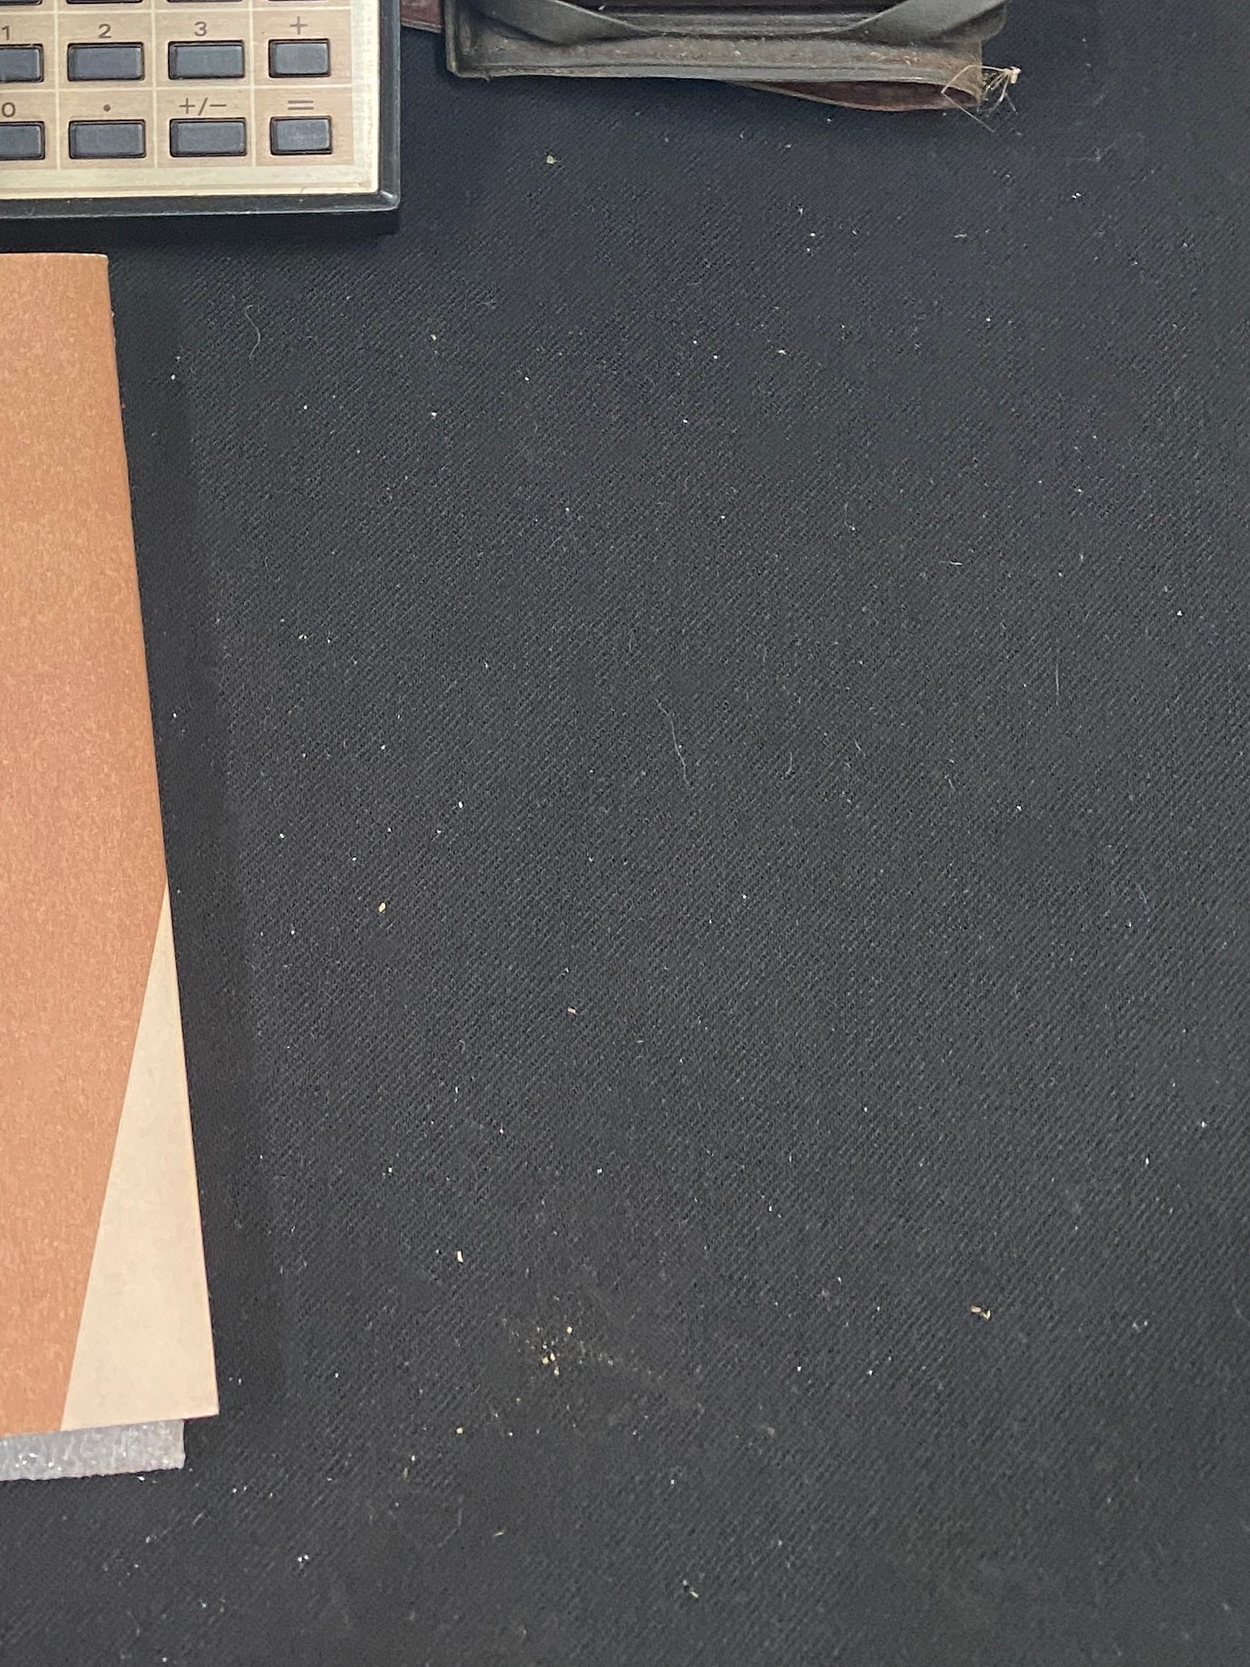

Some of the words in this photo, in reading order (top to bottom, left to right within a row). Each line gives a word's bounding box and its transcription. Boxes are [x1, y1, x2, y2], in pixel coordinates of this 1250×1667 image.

[2, 25, 11, 41] 1
[98, 24, 112, 39] 2
[194, 21, 207, 37] 3
[2, 102, 16, 118] 0
